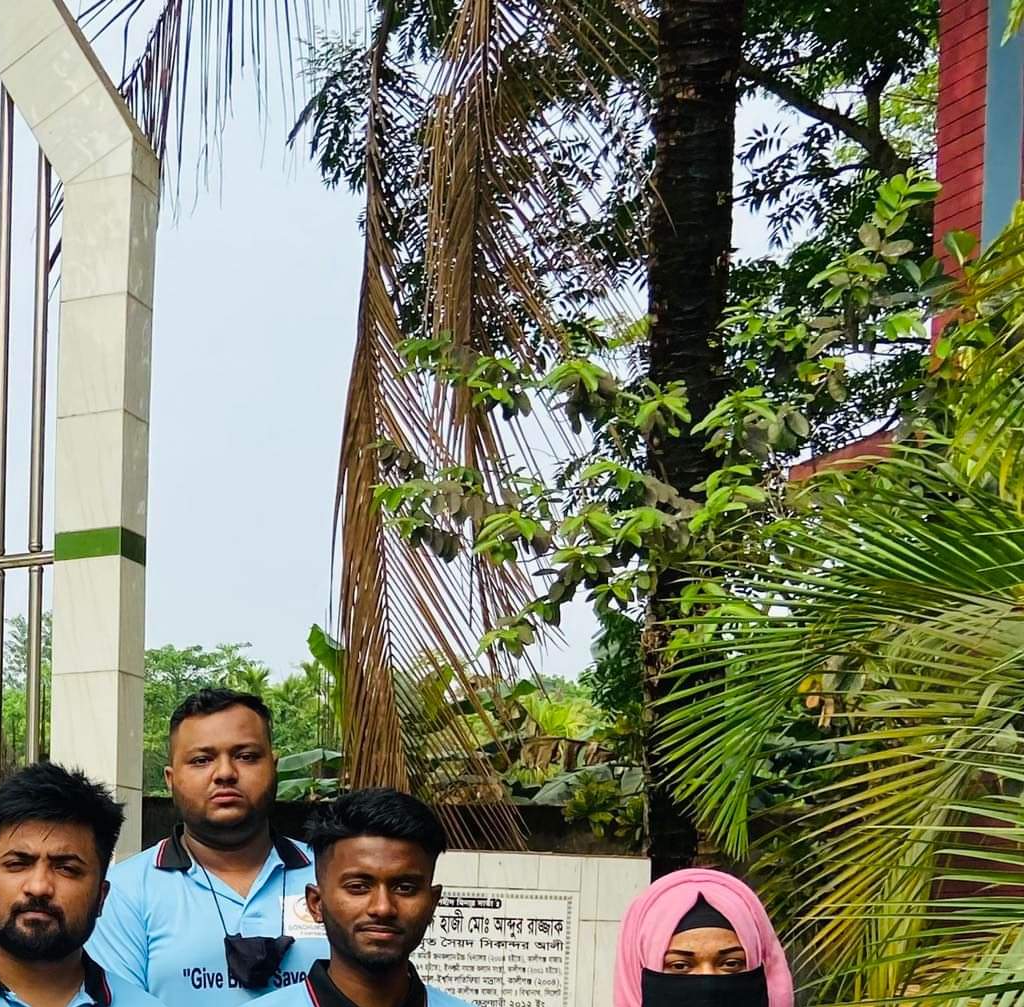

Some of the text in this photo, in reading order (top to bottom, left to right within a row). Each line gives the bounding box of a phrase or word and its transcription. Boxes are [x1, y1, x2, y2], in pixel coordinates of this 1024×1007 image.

[440, 909, 464, 934] হাজী
[468, 916, 490, 934] মোঃ
[493, 917, 523, 938] আব্দুর
[527, 918, 563, 936] রাজ্জাক
[440, 936, 473, 948] সৈয়দ
[480, 938, 529, 950] সিকান্দর
[534, 939, 563, 951] আলী
[183, 968, 224, 989] "Give
